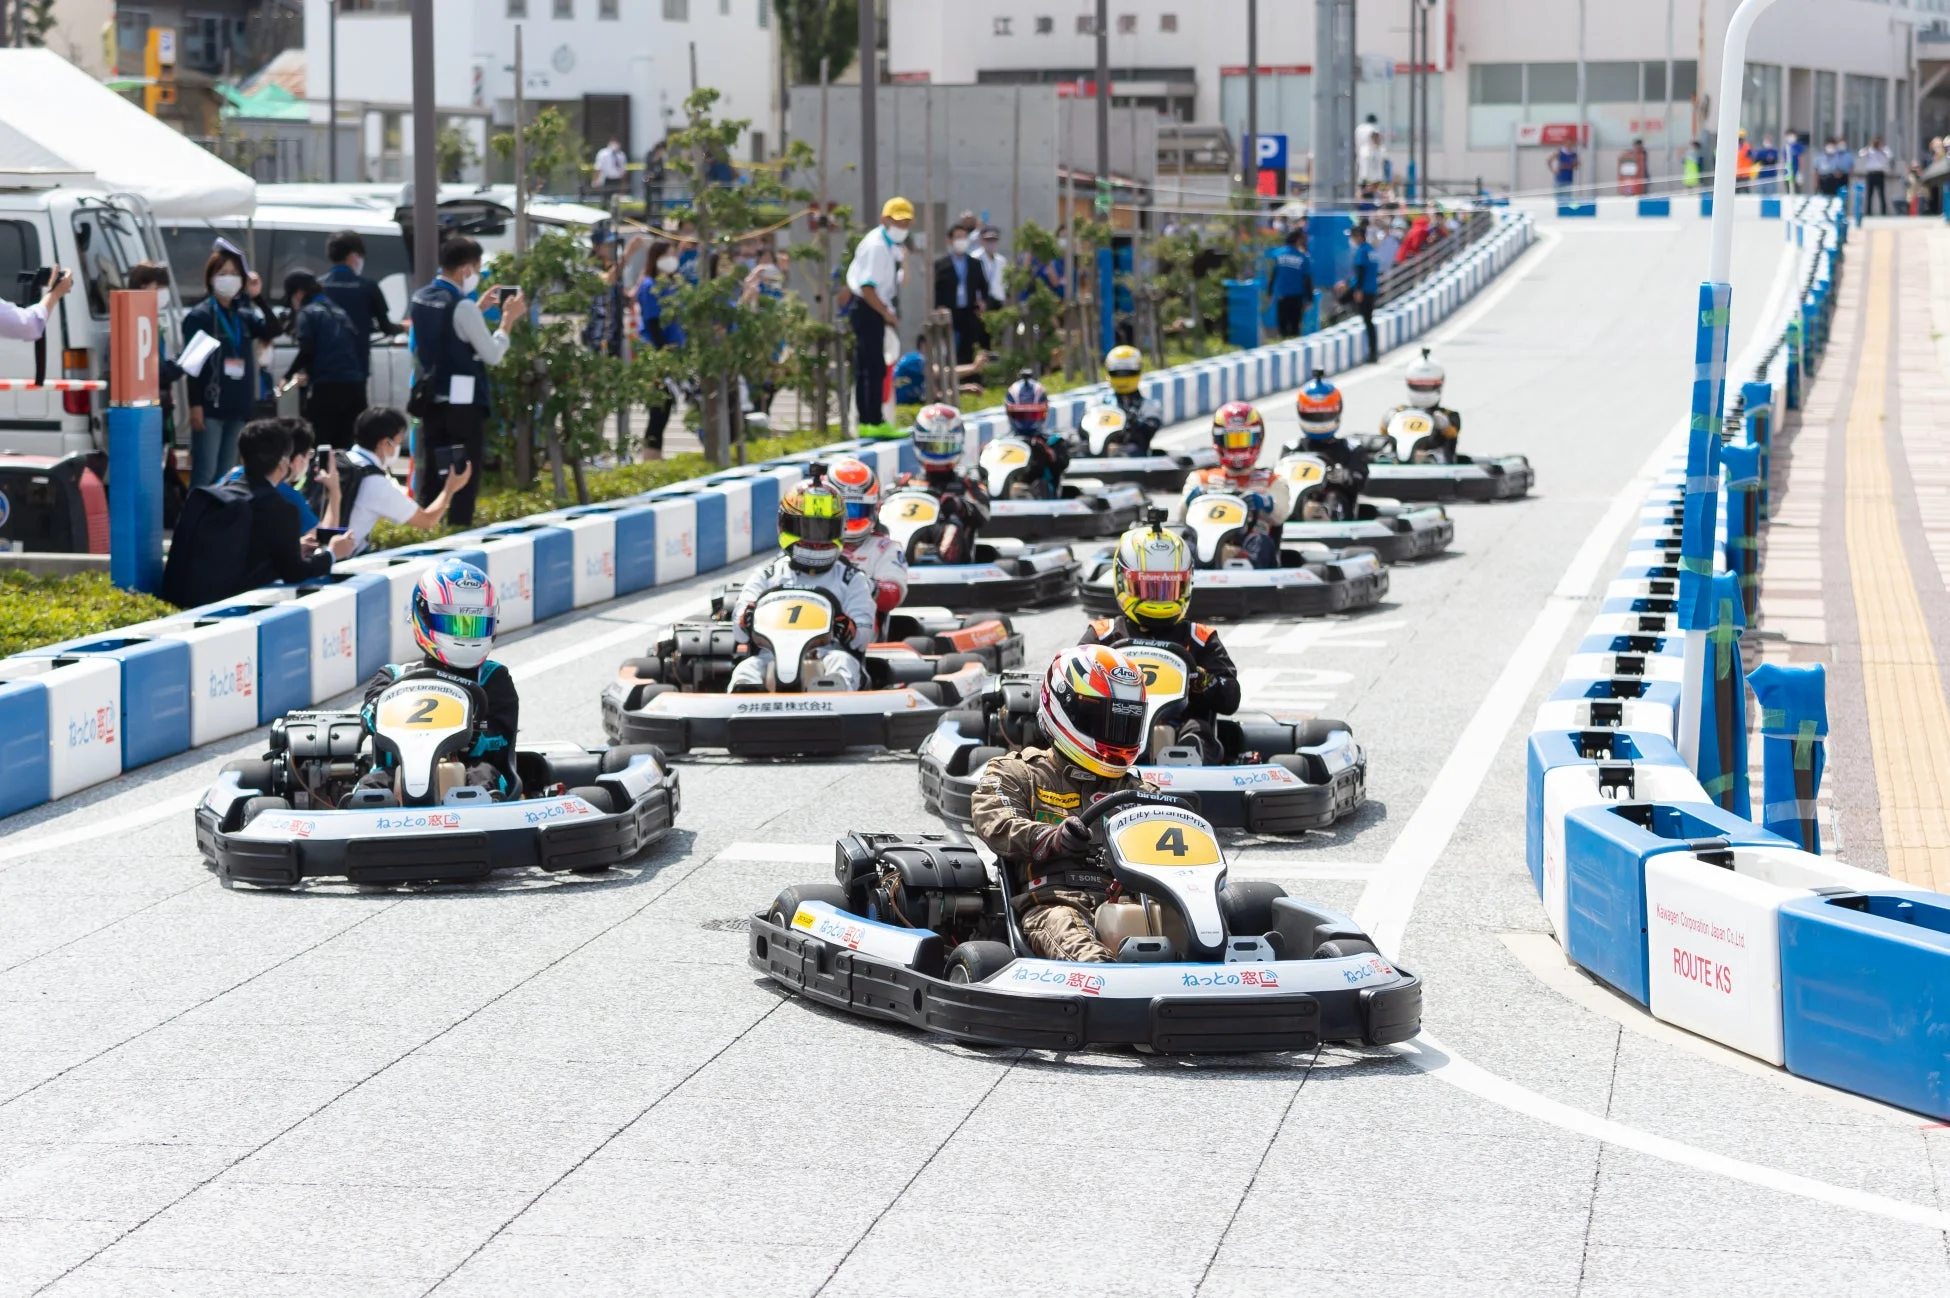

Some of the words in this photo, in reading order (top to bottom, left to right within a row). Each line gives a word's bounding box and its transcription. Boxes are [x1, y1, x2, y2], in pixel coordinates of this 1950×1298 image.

[137, 315, 152, 381] P
[901, 503, 920, 518] 3
[1208, 505, 1228, 520] 6
[786, 605, 803, 624] 1
[1137, 663, 1160, 687] 5
[406, 698, 439, 724] 2
[737, 700, 833, 713] 今井産業株式会社
[1129, 810, 1150, 821] City
[1156, 827, 1189, 857] 4
[1078, 875, 1101, 883] SONE
[1673, 947, 1712, 987] ROUTE
[1715, 963, 1732, 994] KS
